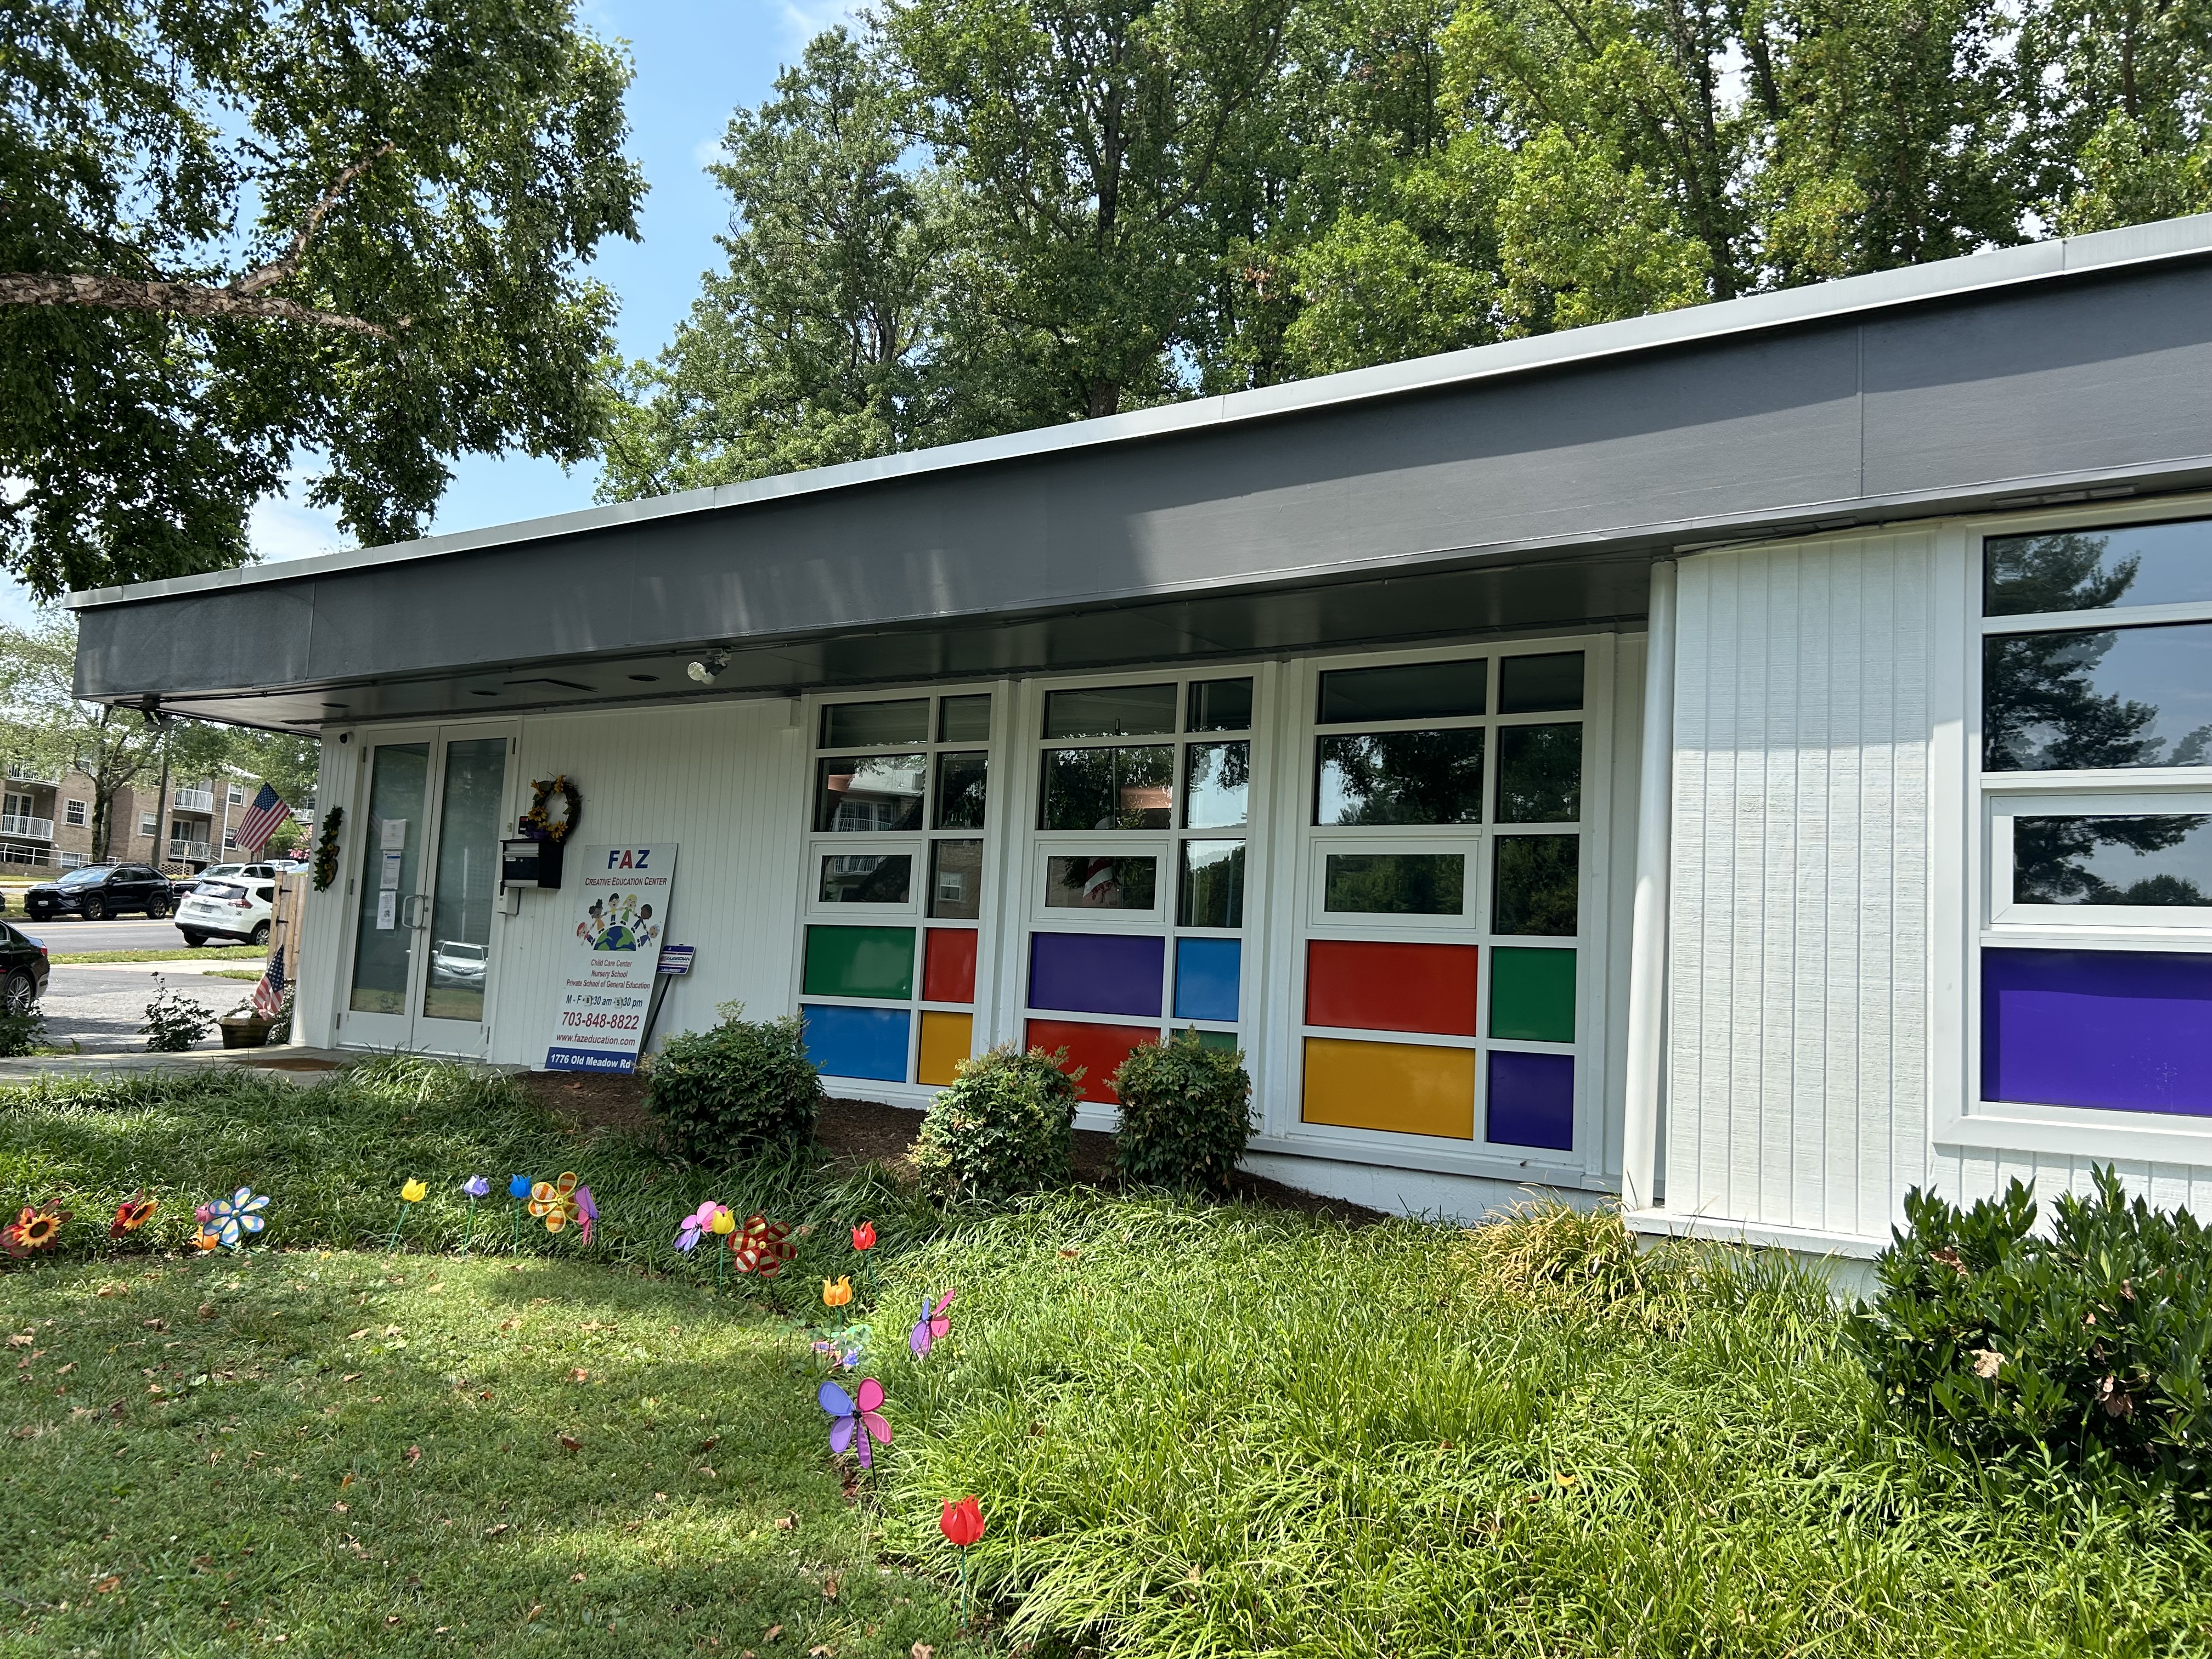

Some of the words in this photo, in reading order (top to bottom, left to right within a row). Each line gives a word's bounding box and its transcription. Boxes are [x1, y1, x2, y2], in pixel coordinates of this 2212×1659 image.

[608, 849, 650, 869] FAZ
[585, 877, 611, 886] CREATIVE
[612, 877, 643, 886] EDUCATION
[644, 877, 667, 885] CENTER
[591, 969, 611, 979] Nursery
[566, 979, 583, 987] Private
[583, 979, 600, 988] School
[606, 980, 625, 989] General
[625, 981, 650, 989] Education
[566, 994, 572, 1004] M
[576, 995, 582, 1005] F
[602, 998, 612, 1006] am
[631, 999, 643, 1009] pm
[561, 1012, 640, 1030] 703-848-8822
[556, 1033, 635, 1046] www.fazeducation.com
[551, 1053, 569, 1064] 1776
[571, 1055, 584, 1065] Old
[585, 1057, 619, 1068] Meadow
[619, 1059, 631, 1069] Rd
